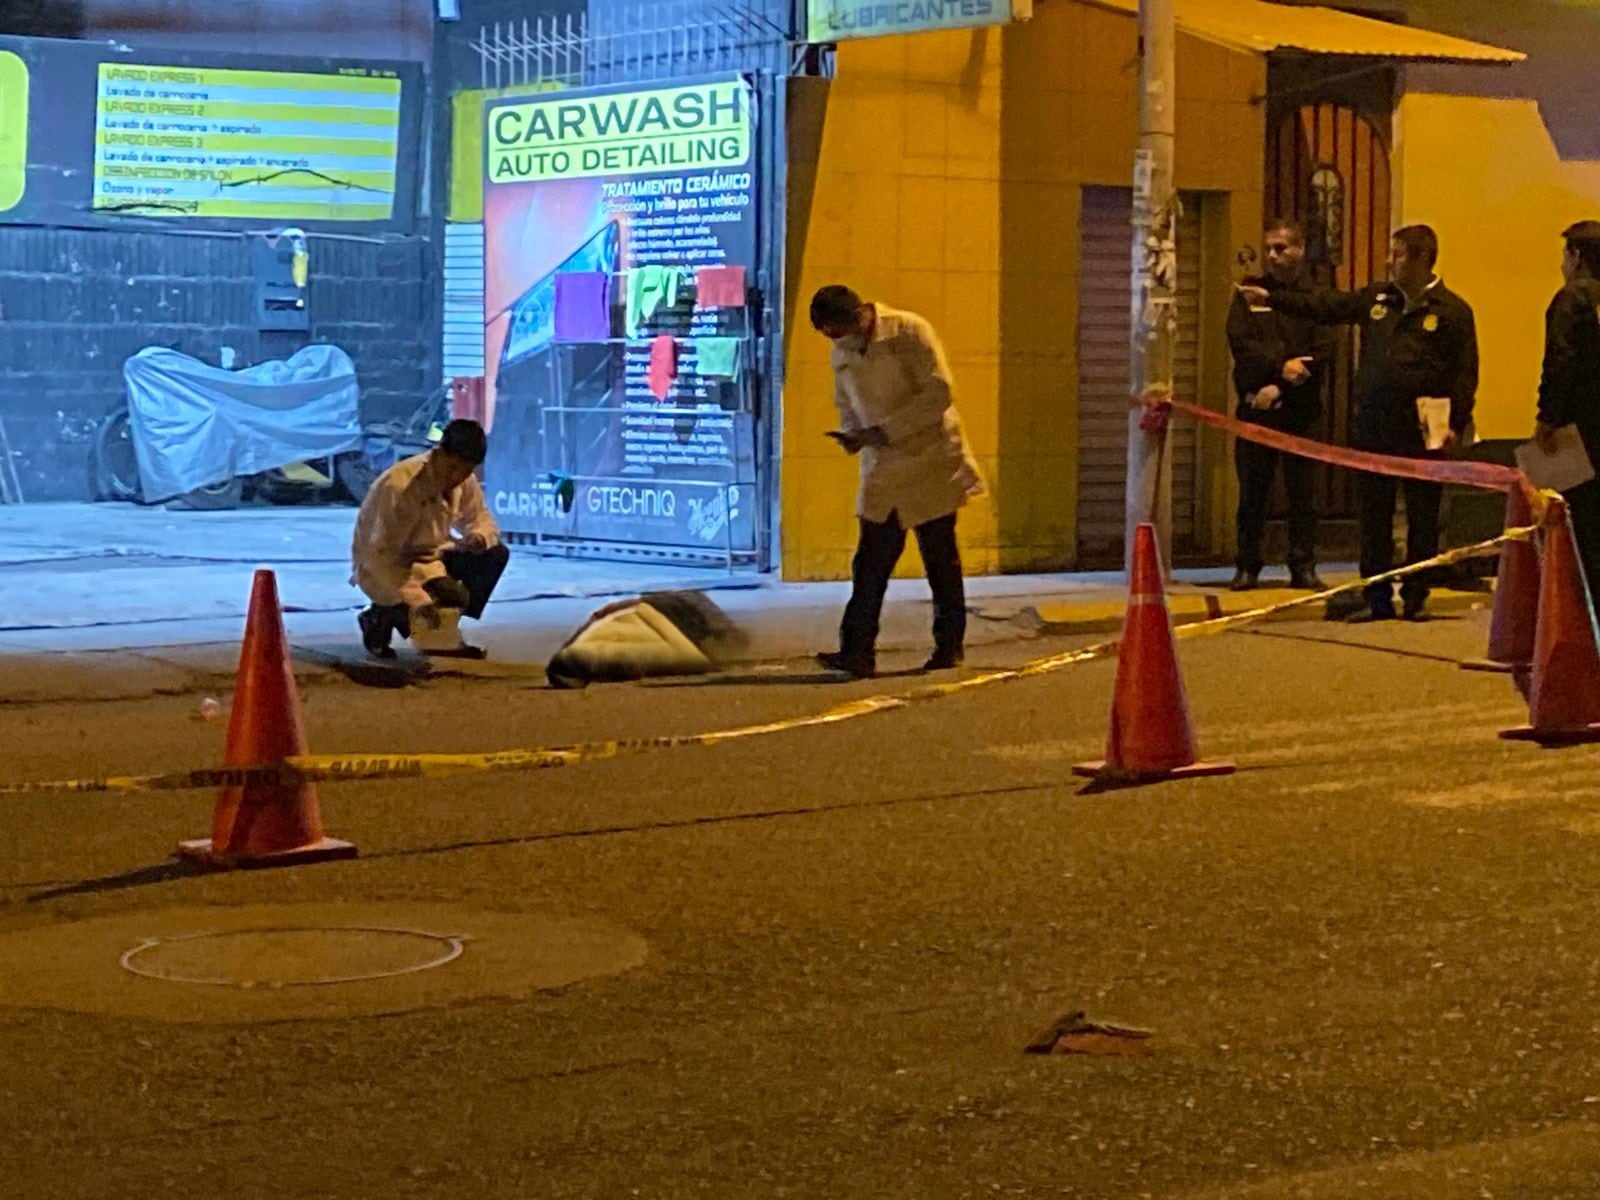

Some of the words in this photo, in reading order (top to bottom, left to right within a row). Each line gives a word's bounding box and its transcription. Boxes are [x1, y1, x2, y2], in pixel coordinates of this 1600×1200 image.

[828, 0, 992, 30] LUBRICANTES
[494, 87, 741, 144] CARWASH
[496, 152, 570, 177] AUTO
[582, 136, 740, 171] DETAILING
[601, 177, 683, 197] TRATAMIENTO
[686, 169, 750, 193] CERÁMICO
[677, 198, 698, 212] para
[698, 196, 709, 208] tu
[710, 192, 750, 207] vehículo
[586, 486, 676, 517] GTECHNIQ
